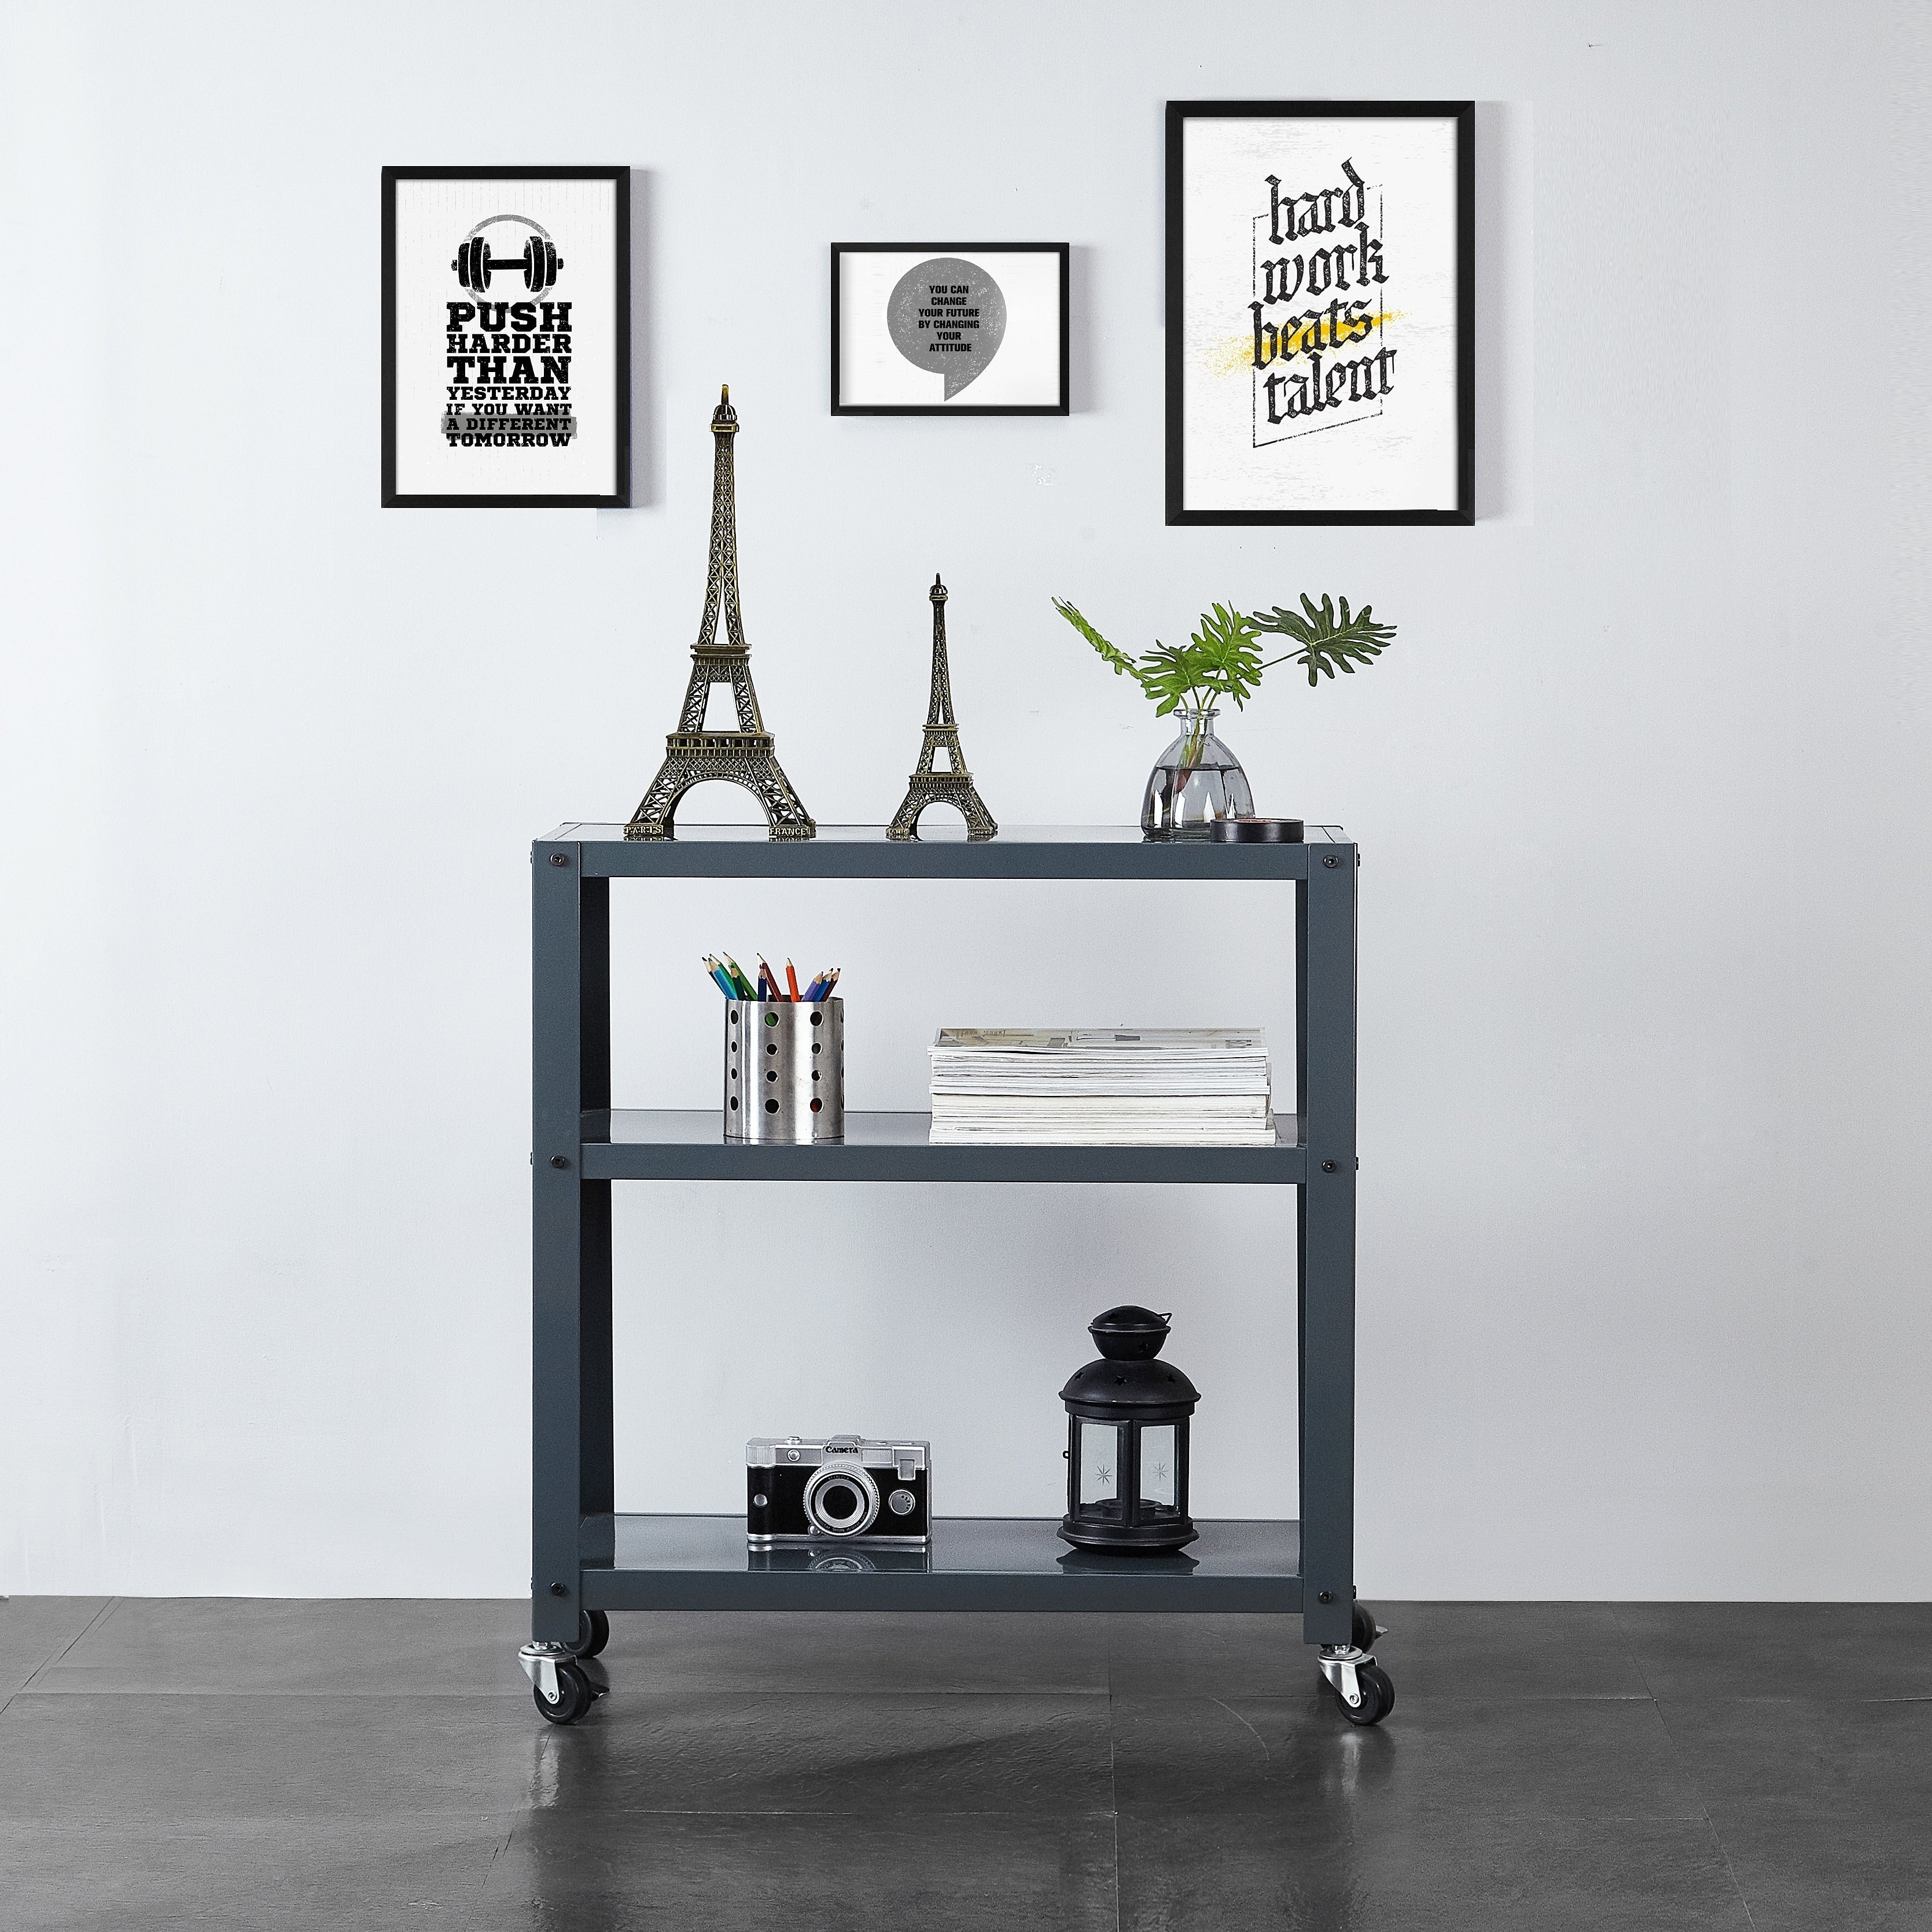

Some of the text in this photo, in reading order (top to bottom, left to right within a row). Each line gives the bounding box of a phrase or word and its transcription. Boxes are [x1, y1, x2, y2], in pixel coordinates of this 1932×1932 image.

[1265, 157, 1365, 245] hard
[1260, 222, 1390, 304] work
[929, 286, 969, 294] YOU CAN
[931, 297, 967, 306] CHANGE
[446, 302, 572, 332] PUSH
[918, 308, 980, 317] YOUR FUTURE
[918, 320, 980, 329] BY CHANGING
[936, 332, 962, 340] YOUR
[1247, 298, 1373, 370] beats
[446, 333, 572, 354] HARDER
[929, 343, 972, 352] ATTITUDE
[447, 356, 572, 384] THAN
[1263, 347, 1397, 424] talent
[446, 386, 572, 400] YESTERDAY
[446, 403, 572, 415] IF YOU WANT
[446, 418, 572, 430] A DIFFERENT
[446, 433, 572, 447] TOMORROW
[625, 826, 661, 834] PARIS
[769, 827, 807, 836] FRANCE
